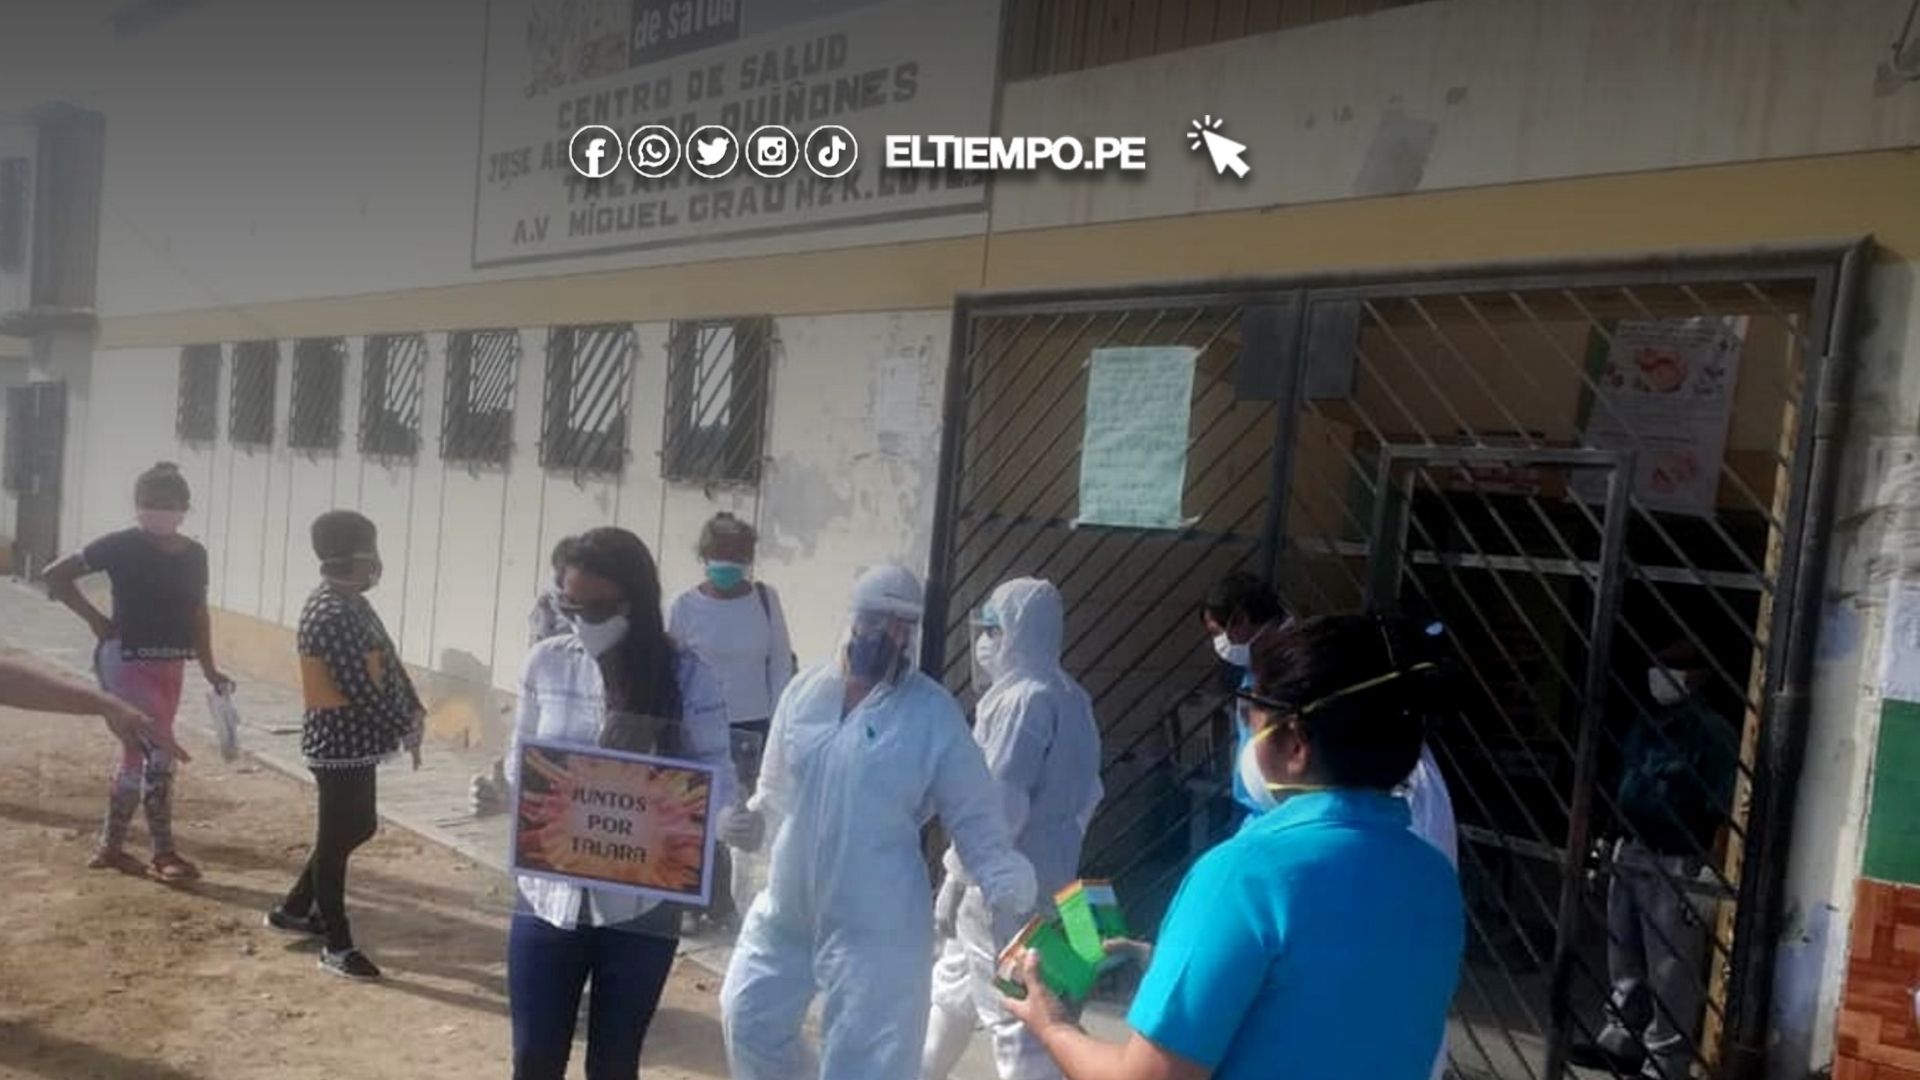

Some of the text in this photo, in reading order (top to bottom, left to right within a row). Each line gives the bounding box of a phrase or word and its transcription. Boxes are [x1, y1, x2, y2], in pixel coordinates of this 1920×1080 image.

[633, 8, 662, 50] de
[557, 33, 848, 130] CENTRO DE SALUD
[687, 180, 788, 223] GRAU
[571, 786, 648, 812] JUNTOS
[587, 813, 633, 836] POR
[571, 837, 647, 863] TALARA
